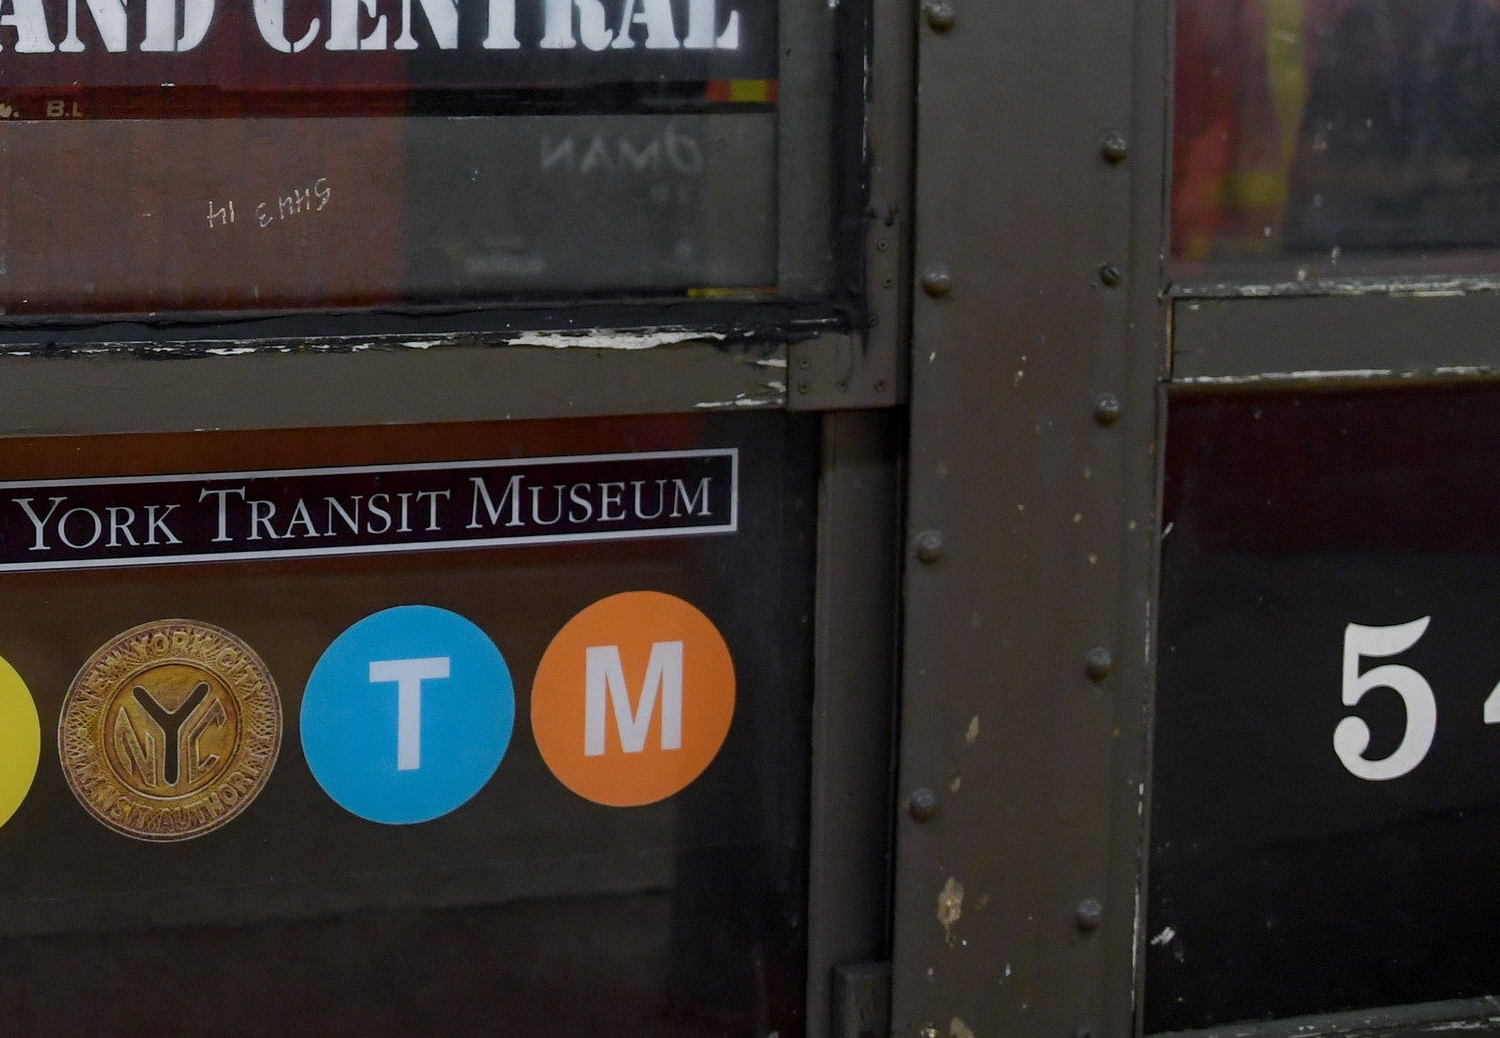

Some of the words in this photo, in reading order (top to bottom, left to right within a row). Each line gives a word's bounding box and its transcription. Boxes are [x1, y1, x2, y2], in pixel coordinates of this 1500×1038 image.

[12, 495, 186, 552] YORK
[196, 484, 454, 542] TRANSIT
[467, 473, 714, 529] MUSEUM
[368, 655, 451, 772] T
[583, 639, 684, 757] M
